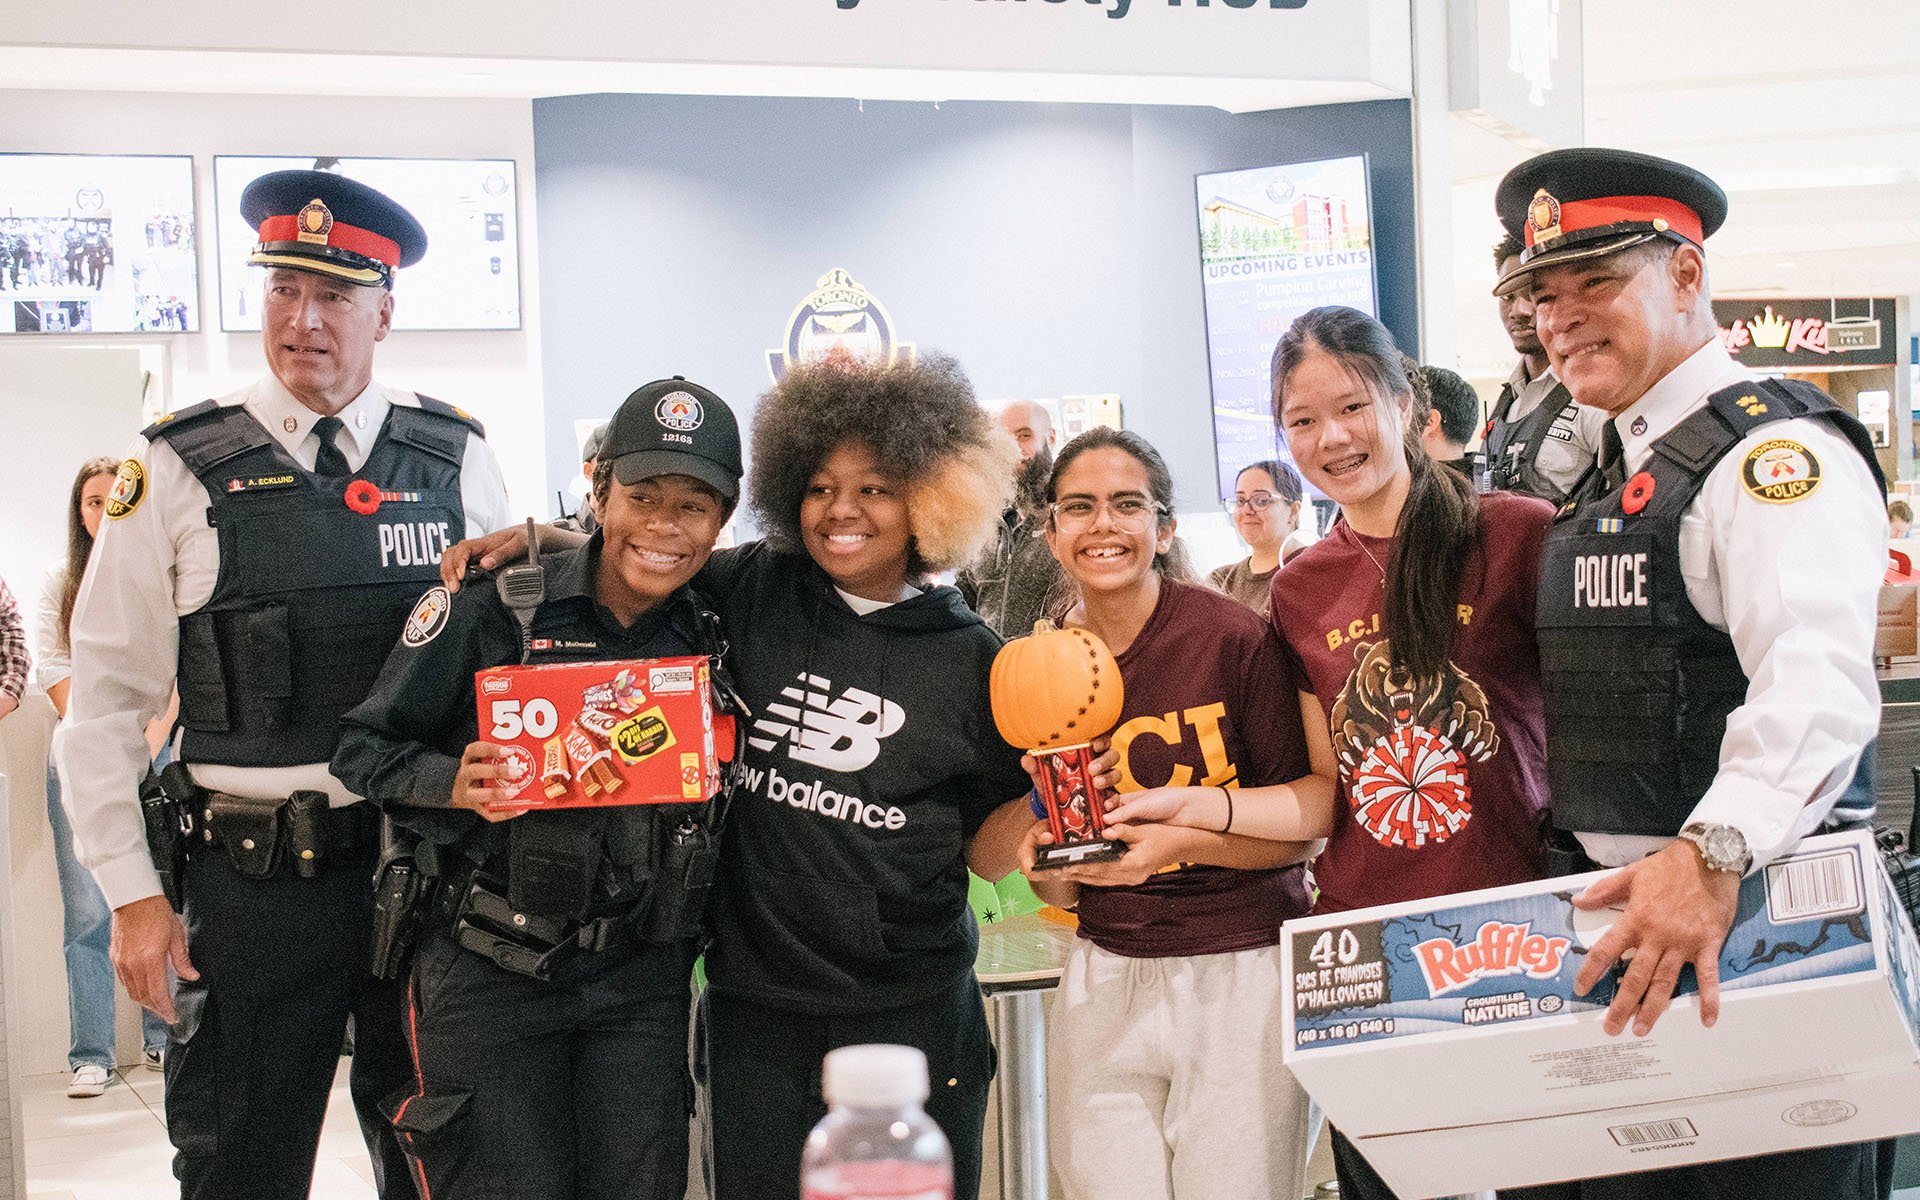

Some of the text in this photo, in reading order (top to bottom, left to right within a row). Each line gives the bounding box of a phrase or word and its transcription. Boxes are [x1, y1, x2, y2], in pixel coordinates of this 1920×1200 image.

[1208, 251, 1367, 278] UPCOMING EVENTS
[1256, 280, 1313, 298] Pumpkin
[1316, 273, 1367, 292] Carving
[809, 290, 868, 310] TORONTO
[665, 418, 693, 429] POLICE
[662, 433, 693, 445] 12163
[1748, 441, 1804, 460] TORONTO
[248, 475, 294, 486] A. ECKLUND
[1765, 481, 1808, 498] POLICE
[378, 522, 451, 568] POLICE
[1573, 553, 1648, 608] POLICE
[491, 698, 559, 740] 50
[619, 728, 636, 749] $2
[1110, 702, 1240, 794] CI
[767, 767, 907, 830] balance
[1309, 928, 1360, 969] 40
[1414, 921, 1570, 996] Ruffles
[1296, 960, 1384, 991] SACS DE FRIANDISES
[1296, 980, 1384, 1010] D'HALLOWEEN
[1466, 991, 1526, 1008] CROUSTILLES
[1463, 1000, 1531, 1024] NATURE
[1297, 1028, 1317, 1045] (40
[1329, 1025, 1344, 1039] 16
[1345, 1022, 1359, 1039] g)
[1360, 1019, 1383, 1034] 640
[1384, 1018, 1395, 1033] g
